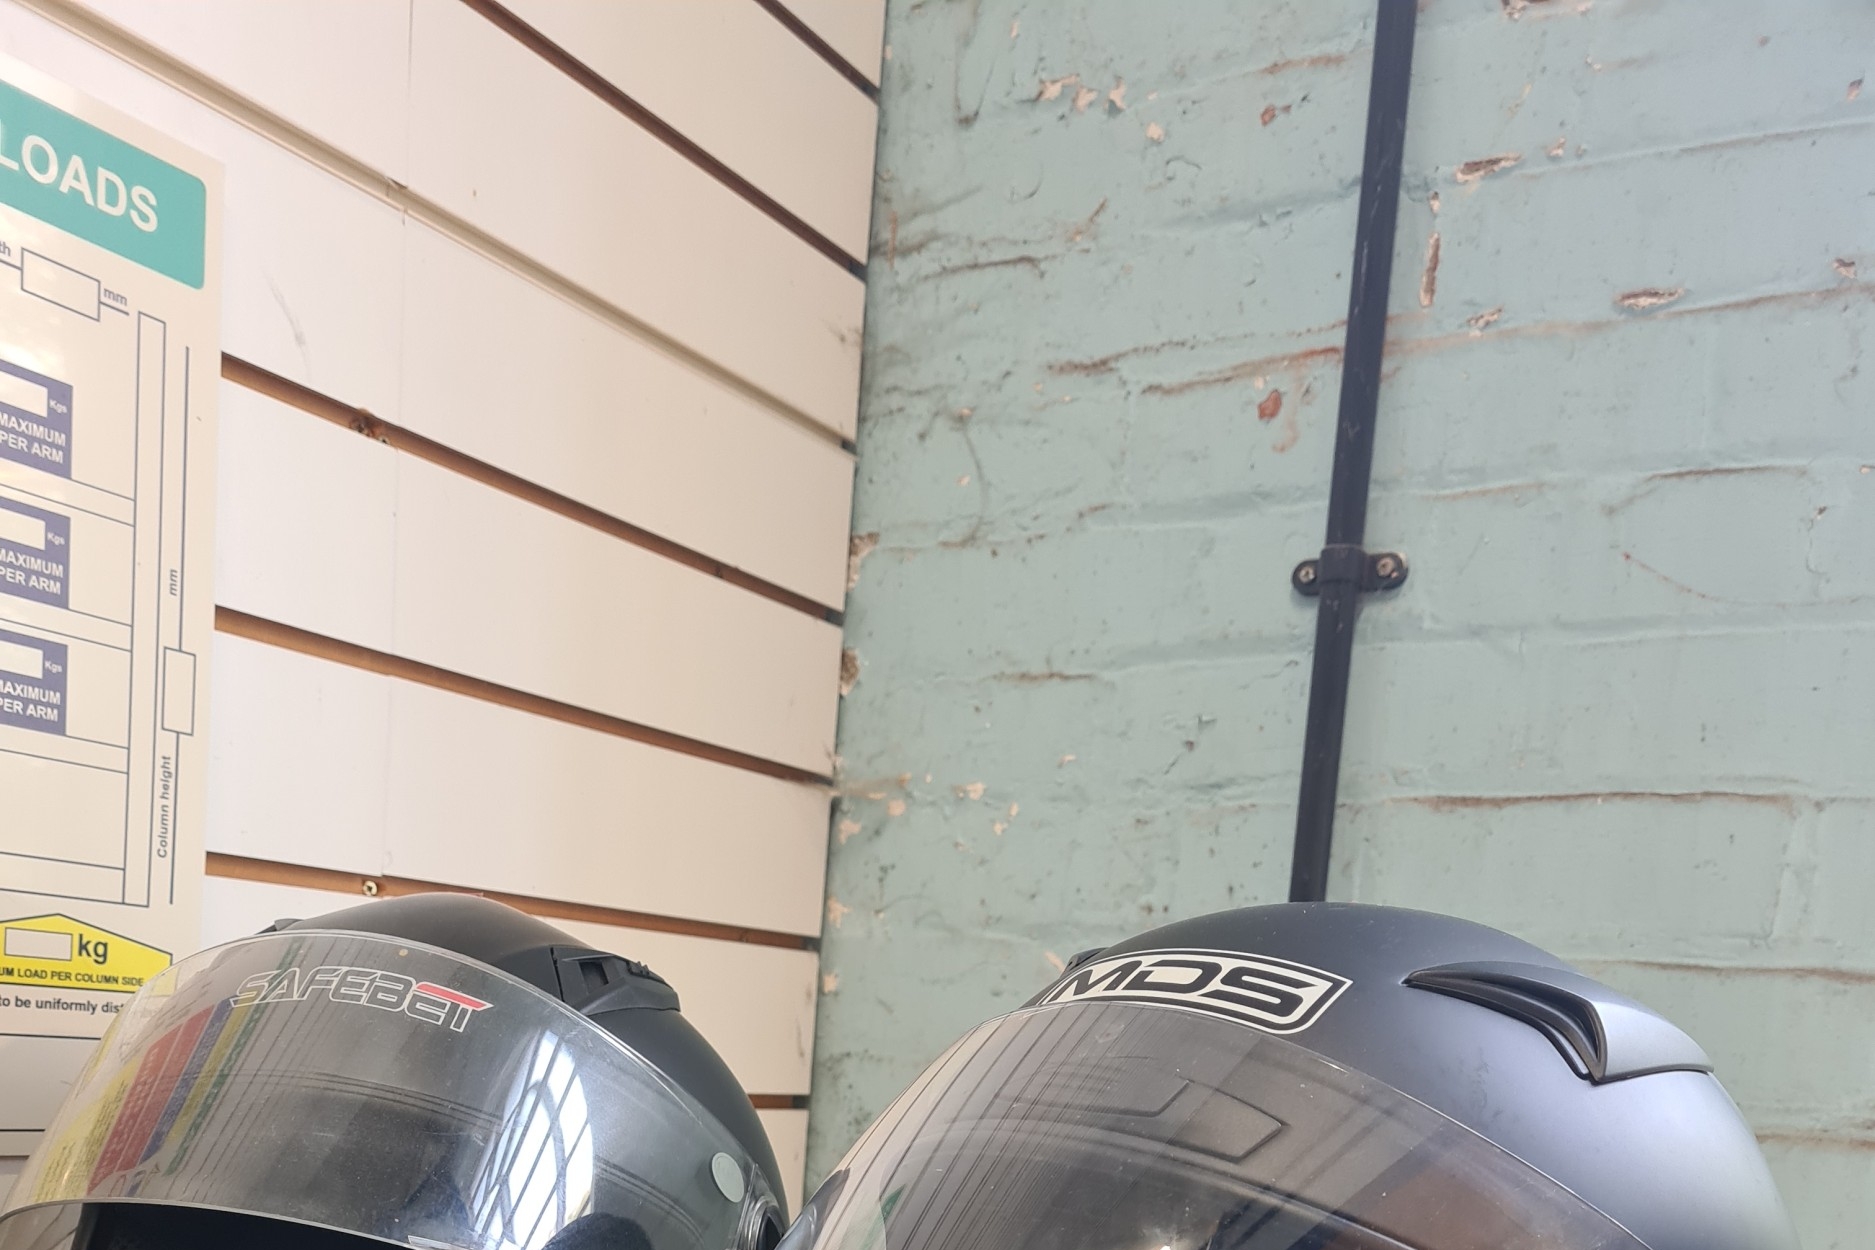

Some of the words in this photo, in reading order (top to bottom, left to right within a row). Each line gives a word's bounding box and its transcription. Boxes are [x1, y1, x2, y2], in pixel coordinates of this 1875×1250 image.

[103, 287, 128, 307] mm
[49, 400, 67, 414] Kgs
[0, 411, 66, 447] MAXIMUM
[31, 441, 64, 464] ARM
[28, 574, 61, 595] ARM
[169, 569, 179, 597] mm
[26, 703, 58, 722] ARM
[160, 755, 172, 800] height
[157, 802, 169, 858] Column
[78, 933, 109, 965] kg
[18, 968, 48, 980] LOAD
[51, 970, 73, 982] PER
[75, 972, 119, 985] COLUMN
[121, 976, 145, 987] SIDE
[1049, 959, 1319, 1018] MDS
[15, 995, 31, 1008] be
[36, 997, 98, 1015] uniformly
[102, 1001, 124, 1014] dis
[230, 965, 494, 1033] SAFEBET
